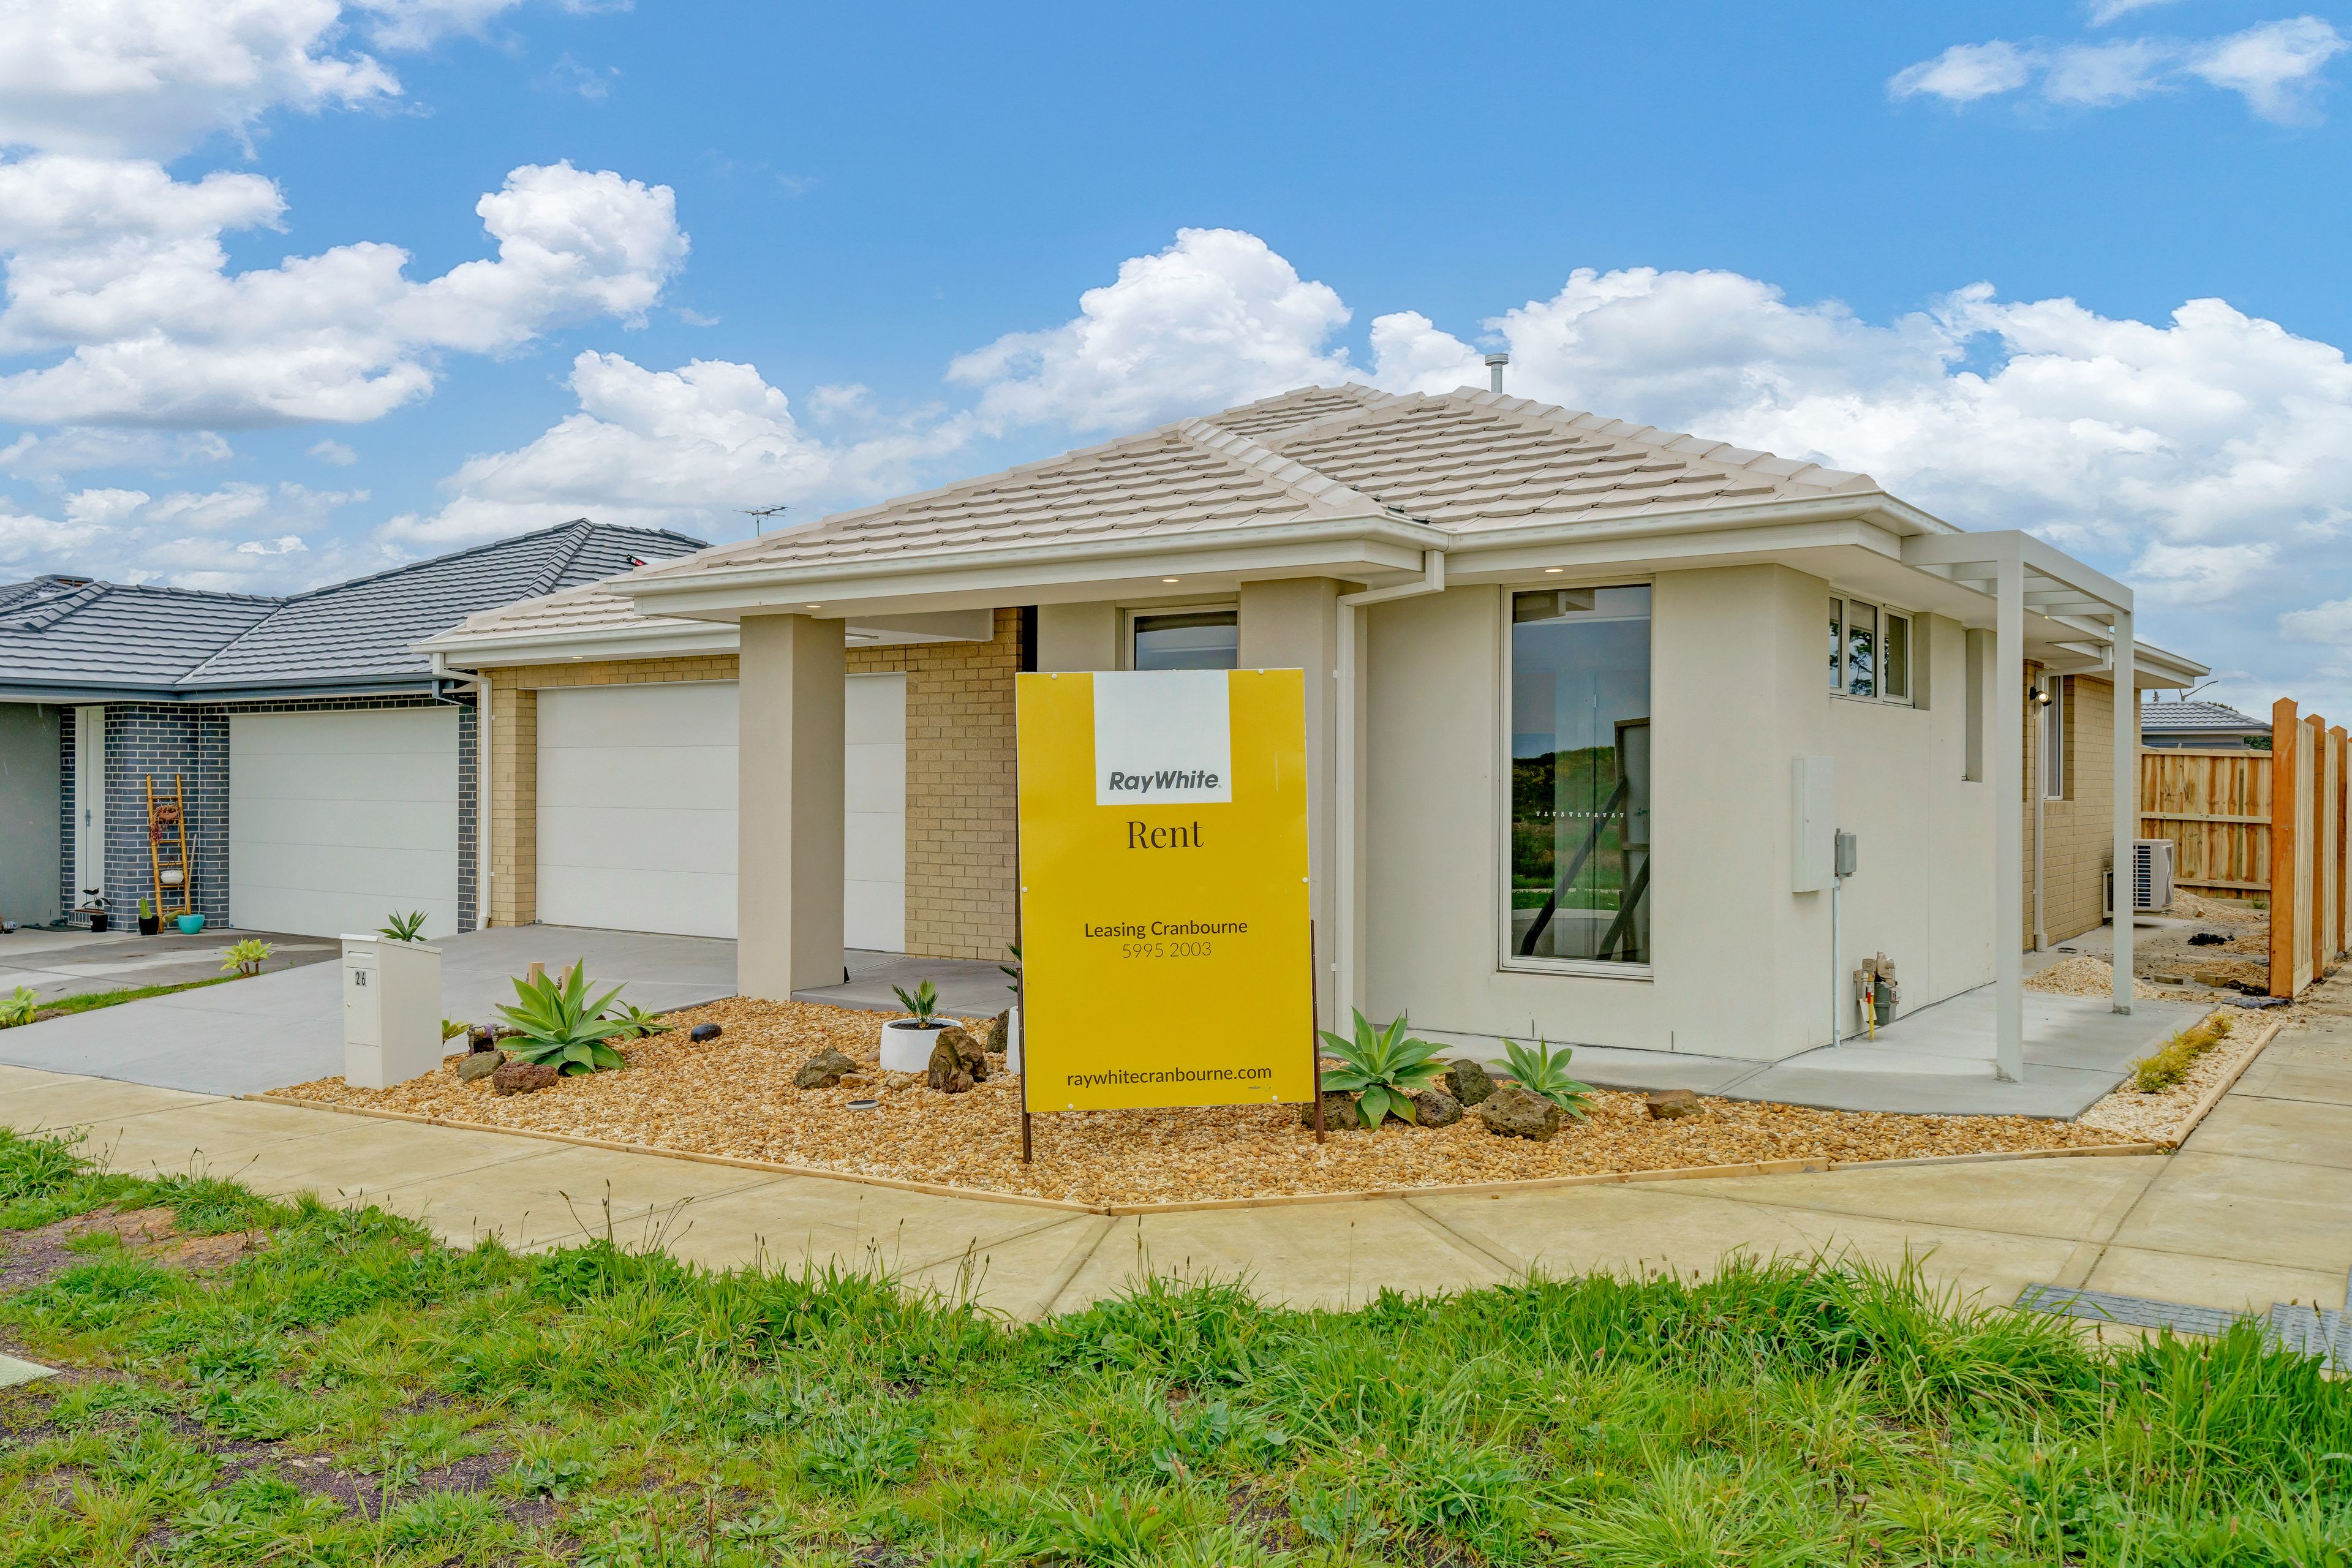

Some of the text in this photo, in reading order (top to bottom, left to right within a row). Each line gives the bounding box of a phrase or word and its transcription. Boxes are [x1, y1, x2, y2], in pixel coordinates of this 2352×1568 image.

[1126, 821, 1204, 849] Rent
[1085, 919, 1248, 940] Leasing Cranbourne
[1122, 941, 1212, 959] 5995 2003
[356, 971, 366, 986] 26
[1068, 1067, 1272, 1088] raywhitecranbourne.com
